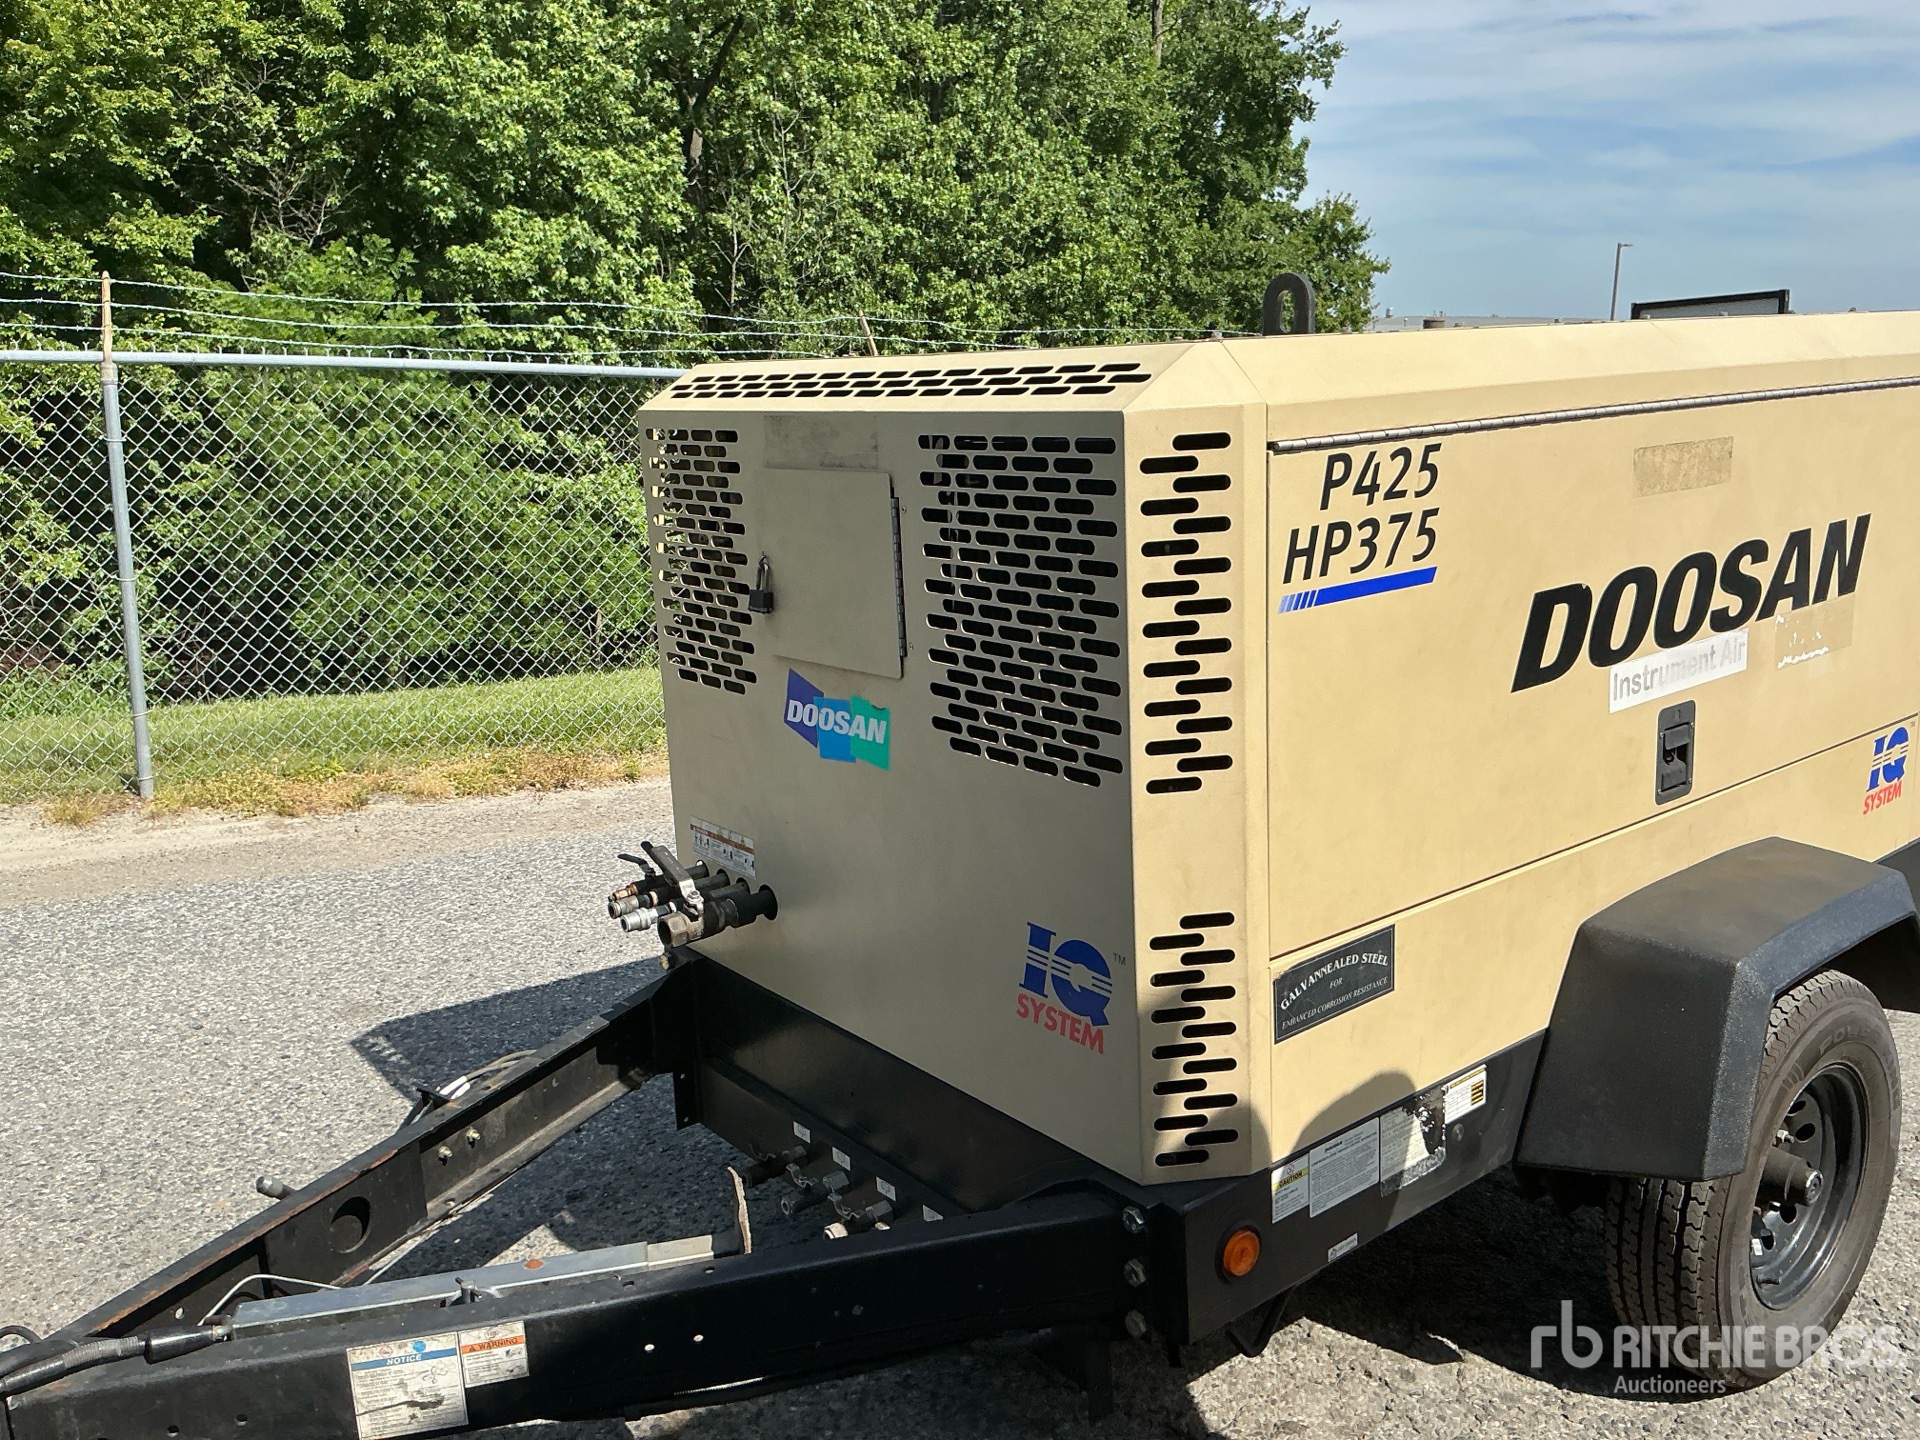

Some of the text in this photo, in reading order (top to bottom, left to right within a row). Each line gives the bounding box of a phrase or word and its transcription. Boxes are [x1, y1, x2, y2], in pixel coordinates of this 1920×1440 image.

[1320, 443, 1442, 510] P425
[1283, 508, 1439, 584] HP375
[1511, 513, 1871, 693] DOOSAN
[1613, 635, 1745, 701] Instrument Air
[787, 699, 887, 744] DOOSAN
[1863, 780, 1902, 815] SYSTEM
[1019, 921, 1112, 1026] IQ
[1280, 952, 1388, 1010] GALVANNEALED STEEL
[1329, 977, 1343, 989] FOR
[1016, 992, 1104, 1054] SYSTEM
[1282, 976, 1388, 1029] ENHANCED CORROSION RESISTANCE
[1279, 1171, 1303, 1188] CAUTION
[386, 1353, 422, 1366] NOTICE
[479, 1336, 518, 1351] WARNING
